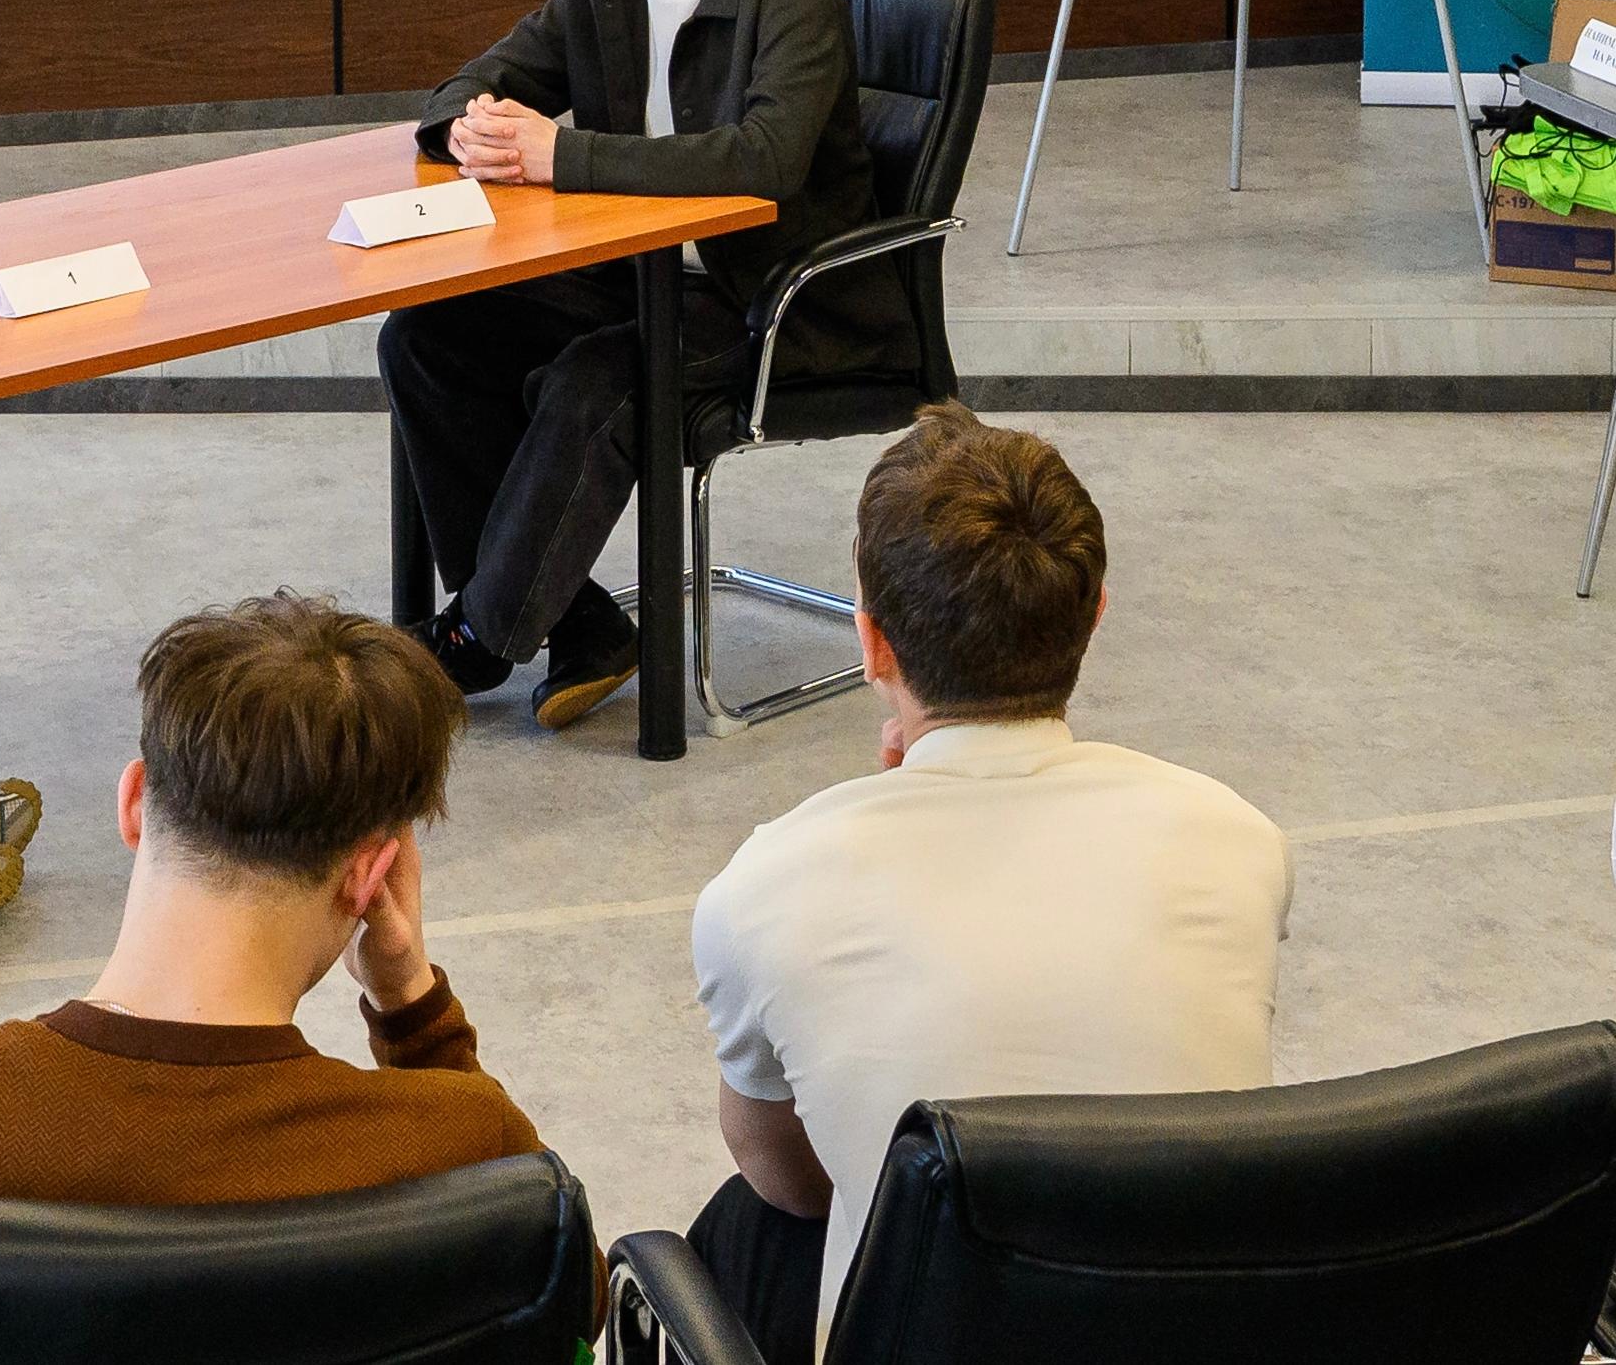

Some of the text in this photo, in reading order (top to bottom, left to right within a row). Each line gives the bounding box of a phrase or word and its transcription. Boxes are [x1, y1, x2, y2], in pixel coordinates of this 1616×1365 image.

[1592, 49, 1605, 62] НА
[415, 203, 427, 217] 2
[67, 271, 77, 285] 1
